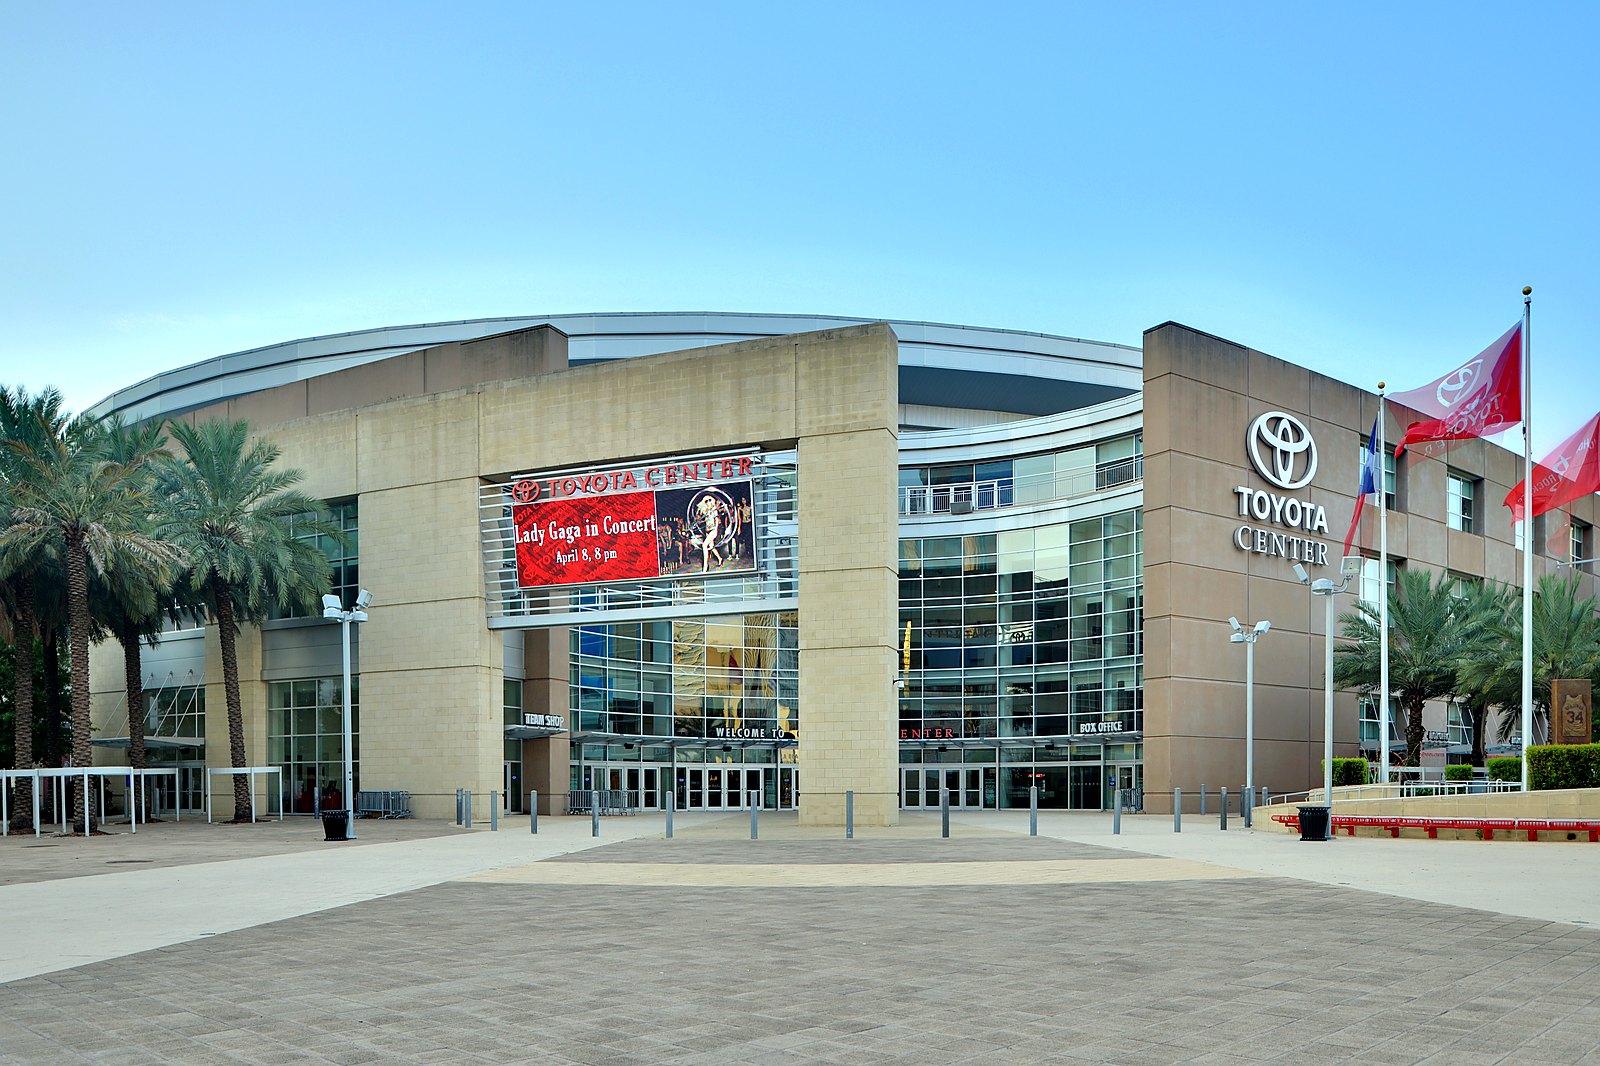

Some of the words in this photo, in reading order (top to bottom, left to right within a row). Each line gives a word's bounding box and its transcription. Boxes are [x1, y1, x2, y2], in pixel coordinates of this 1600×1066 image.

[546, 471, 637, 497] TOYOTA
[644, 456, 753, 486] CENTER
[1234, 486, 1329, 533] TOYOTA
[514, 522, 545, 546] Lady
[549, 521, 581, 543] Gaga
[585, 518, 599, 537] in
[603, 515, 656, 535] Concert
[1234, 525, 1329, 566] CENTER
[556, 549, 579, 566] April
[581, 548, 592, 562] 8,
[594, 547, 602, 560] 8
[604, 550, 617, 563] pm
[524, 713, 545, 726] TEAM
[545, 715, 565, 727] SHOP
[1566, 710, 1584, 724] 34
[716, 727, 765, 738] WELCOME
[771, 729, 785, 738] TO
[900, 727, 954, 739] ENTER
[1080, 722, 1097, 733] BOX
[1098, 721, 1123, 732] OFFICE
